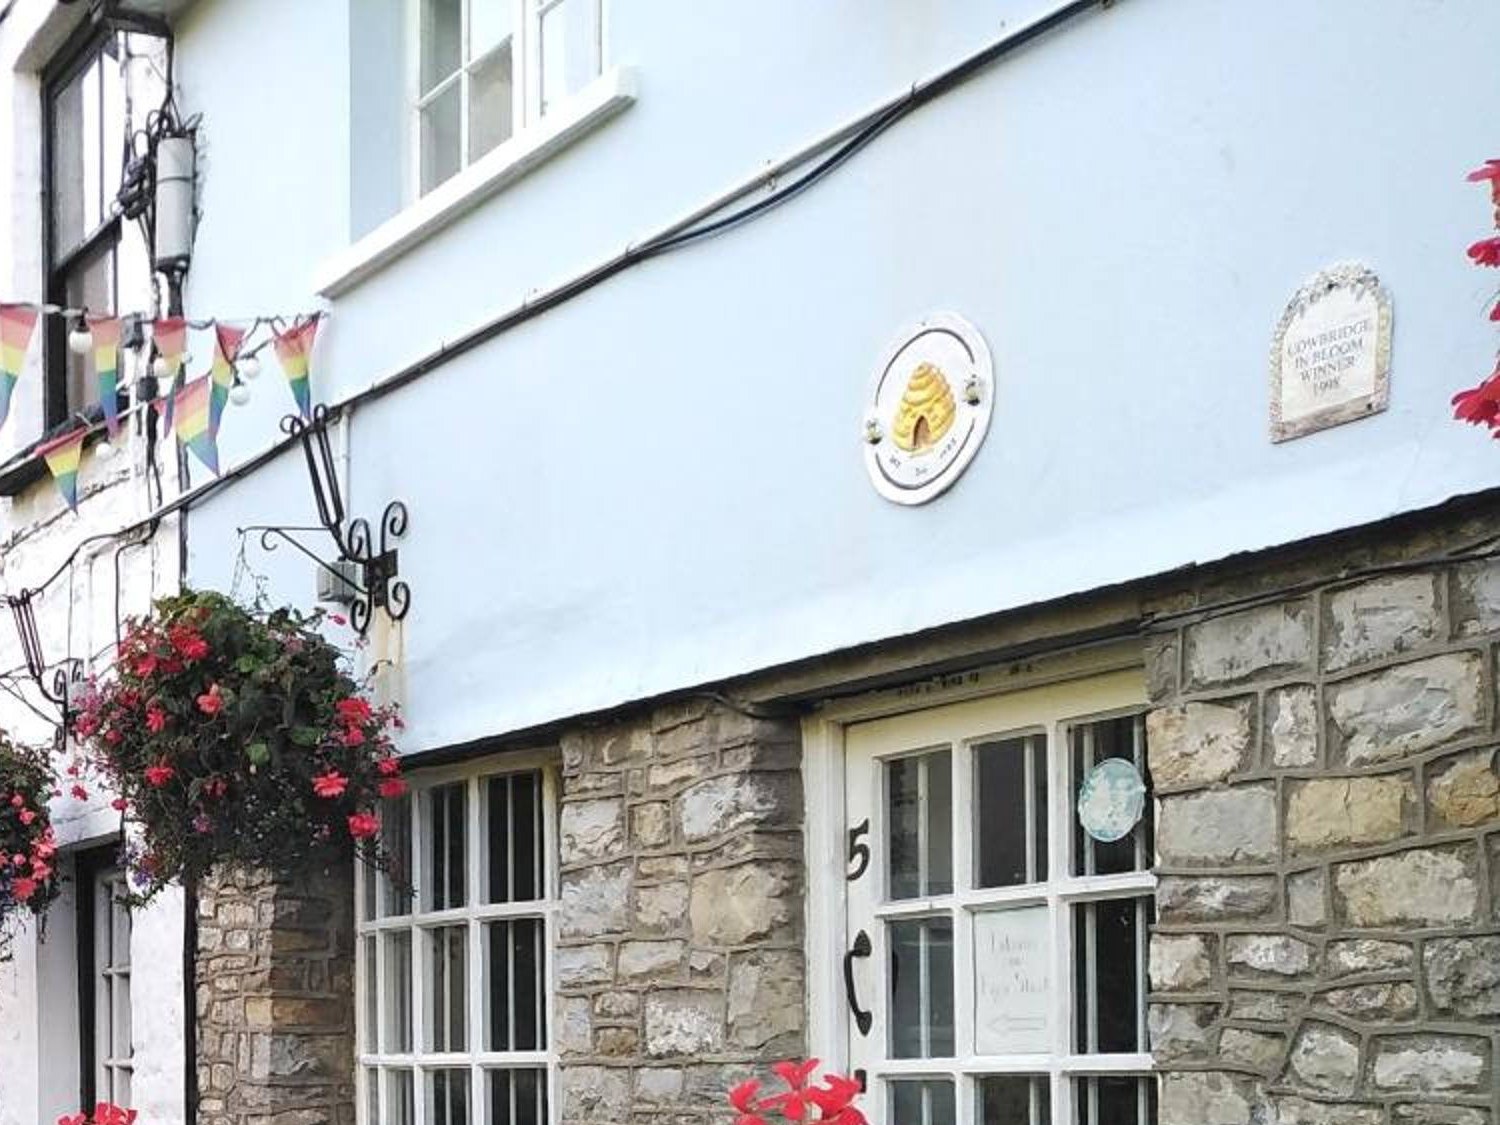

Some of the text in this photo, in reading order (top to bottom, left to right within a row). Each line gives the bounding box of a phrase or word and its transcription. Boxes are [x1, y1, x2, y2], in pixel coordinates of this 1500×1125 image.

[1295, 336, 1363, 369] IN BLOOM
[1300, 355, 1355, 382] WINNER
[846, 818, 870, 881] 5
